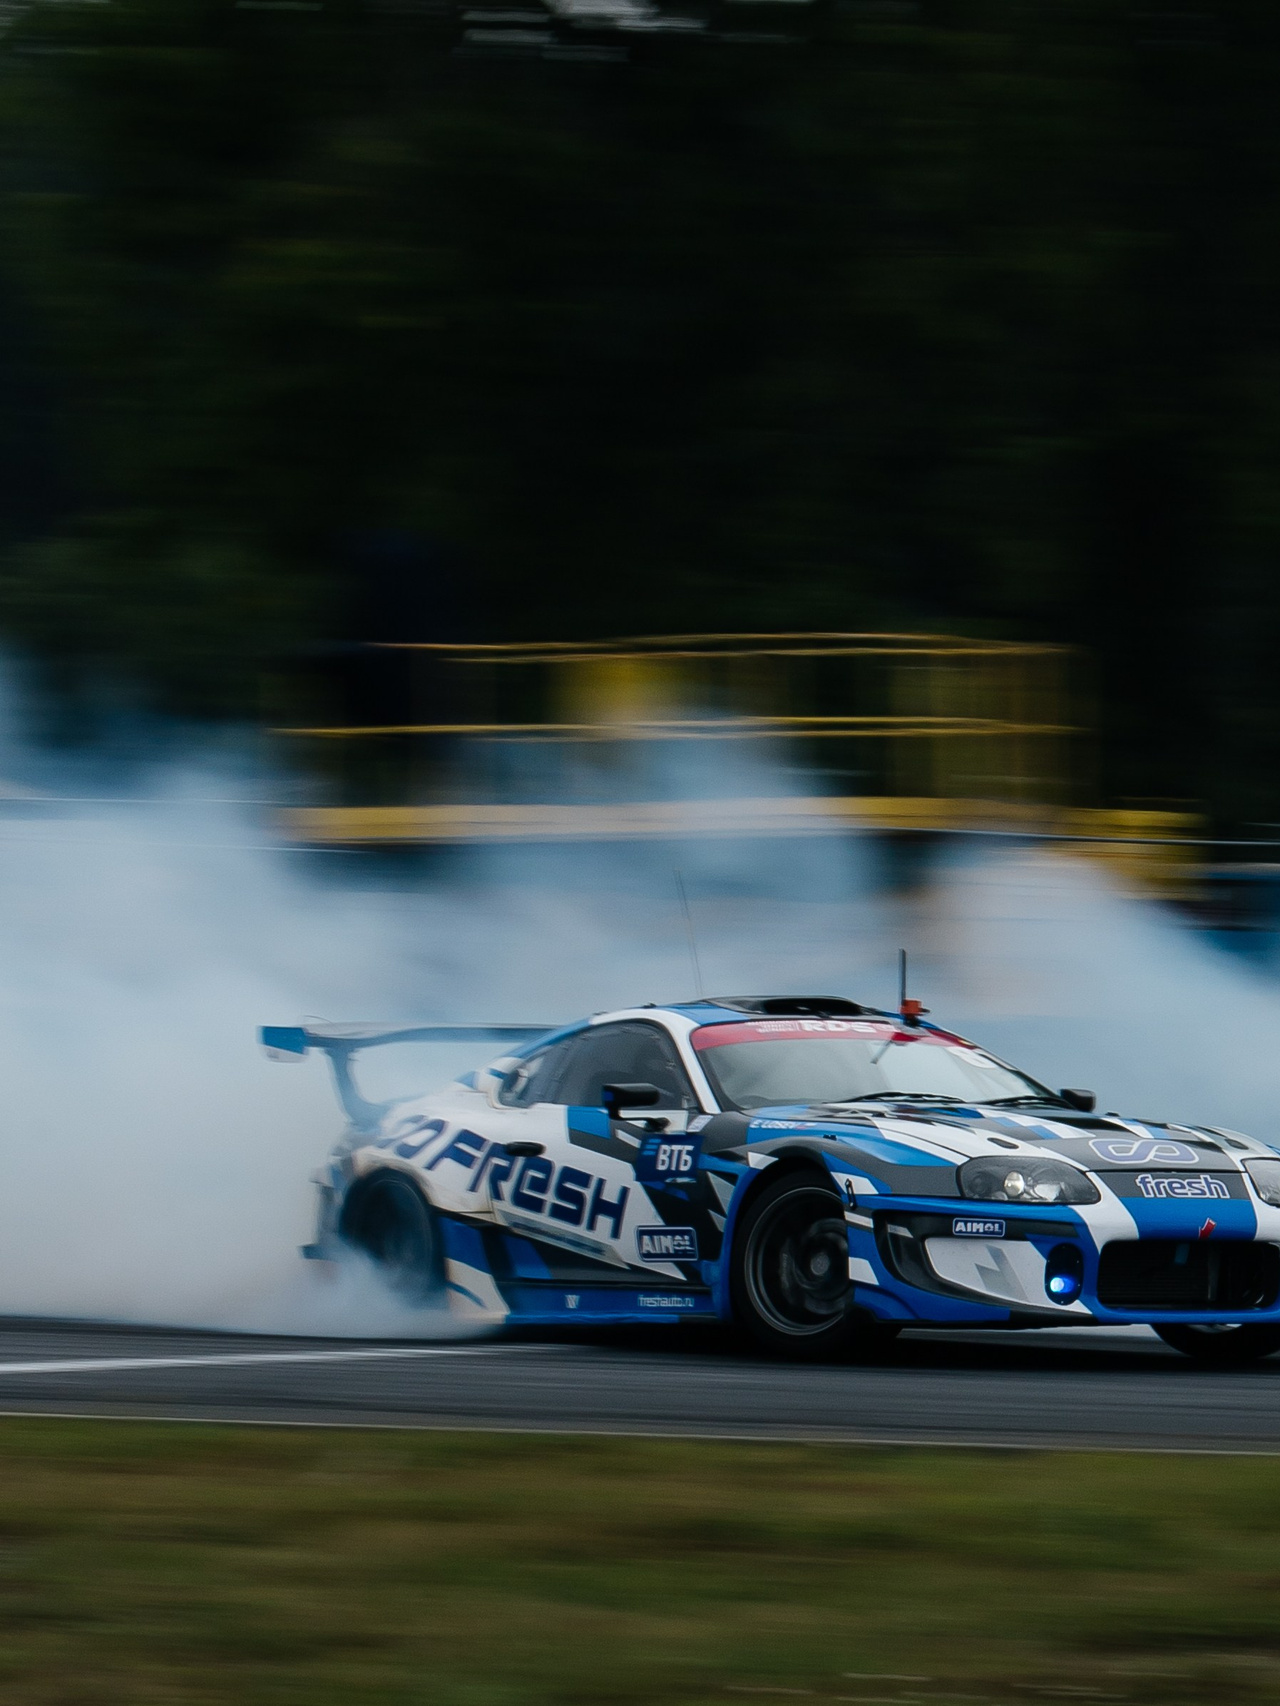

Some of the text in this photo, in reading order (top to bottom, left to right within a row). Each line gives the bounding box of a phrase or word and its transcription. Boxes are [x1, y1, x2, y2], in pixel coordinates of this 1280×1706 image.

[798, 1020, 877, 1033] RDS
[656, 1144, 695, 1171] ВТБ
[1136, 1173, 1231, 1199] fresh
[955, 1221, 1002, 1233] AIMOL
[641, 1234, 695, 1254] AIMOL
